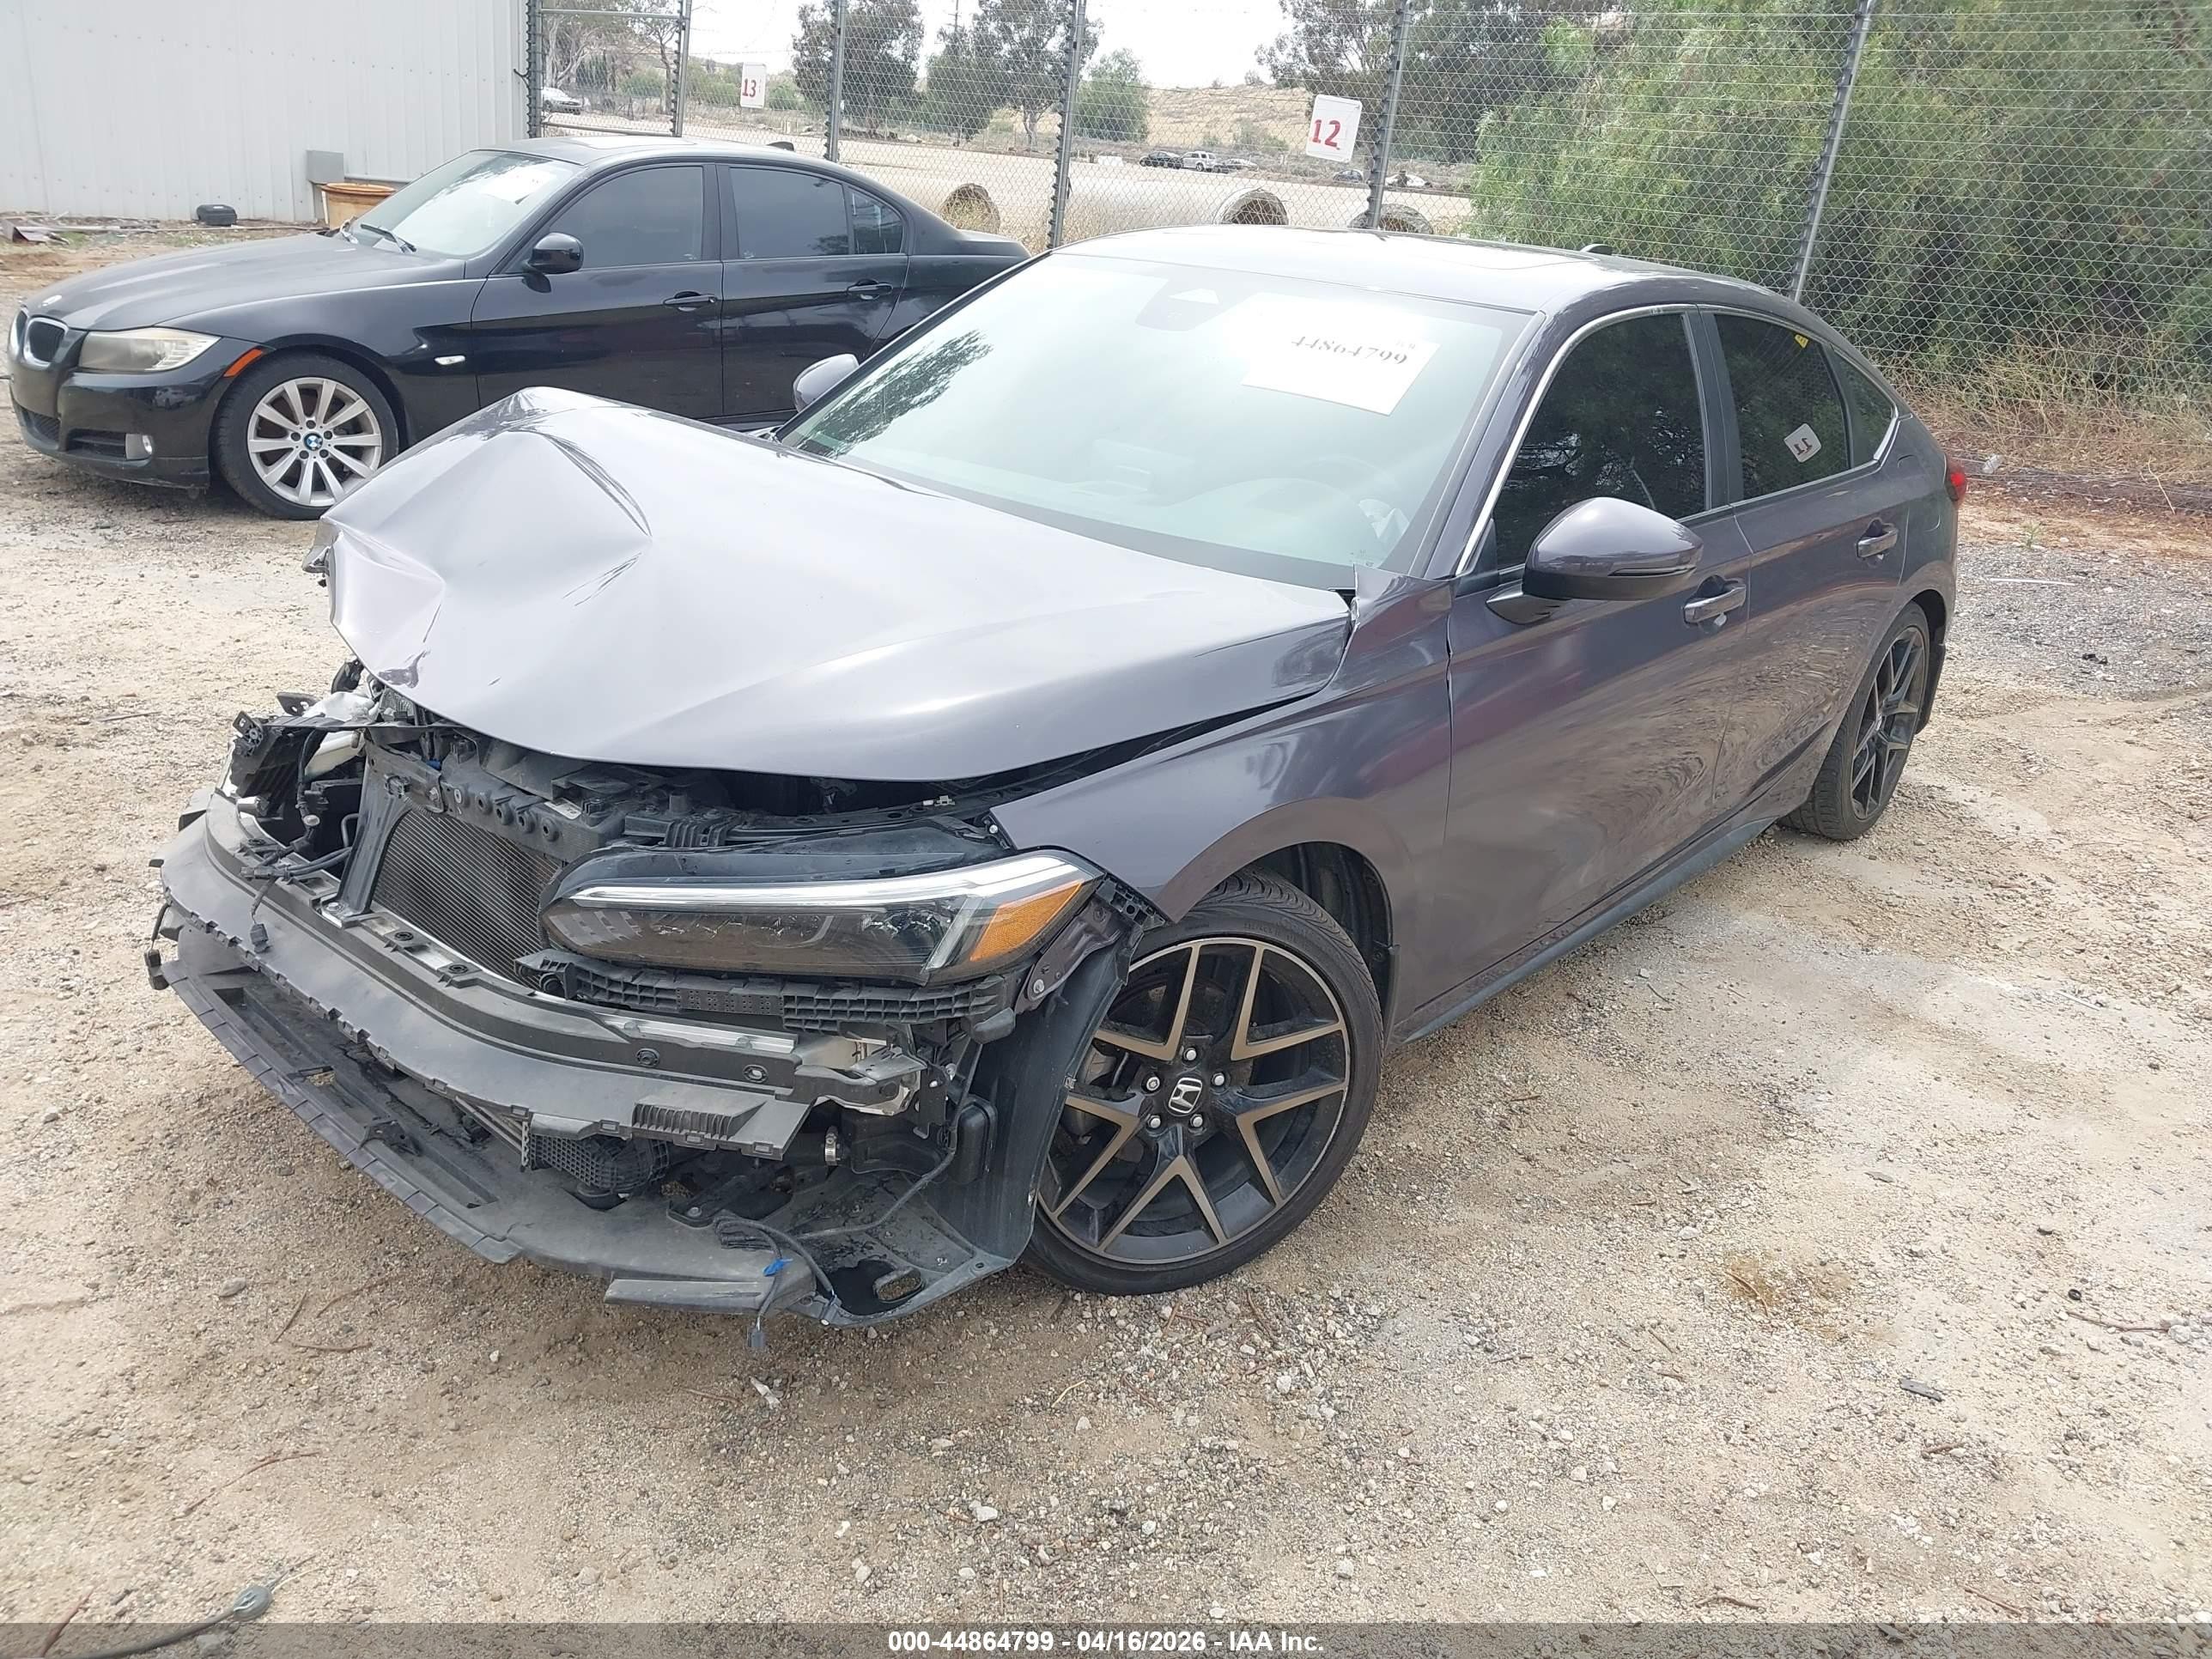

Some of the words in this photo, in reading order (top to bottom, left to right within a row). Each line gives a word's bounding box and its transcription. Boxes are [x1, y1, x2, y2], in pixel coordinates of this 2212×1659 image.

[741, 77, 757, 98] 13
[1311, 118, 1341, 149] 12
[1291, 336, 1408, 365] 44864799
